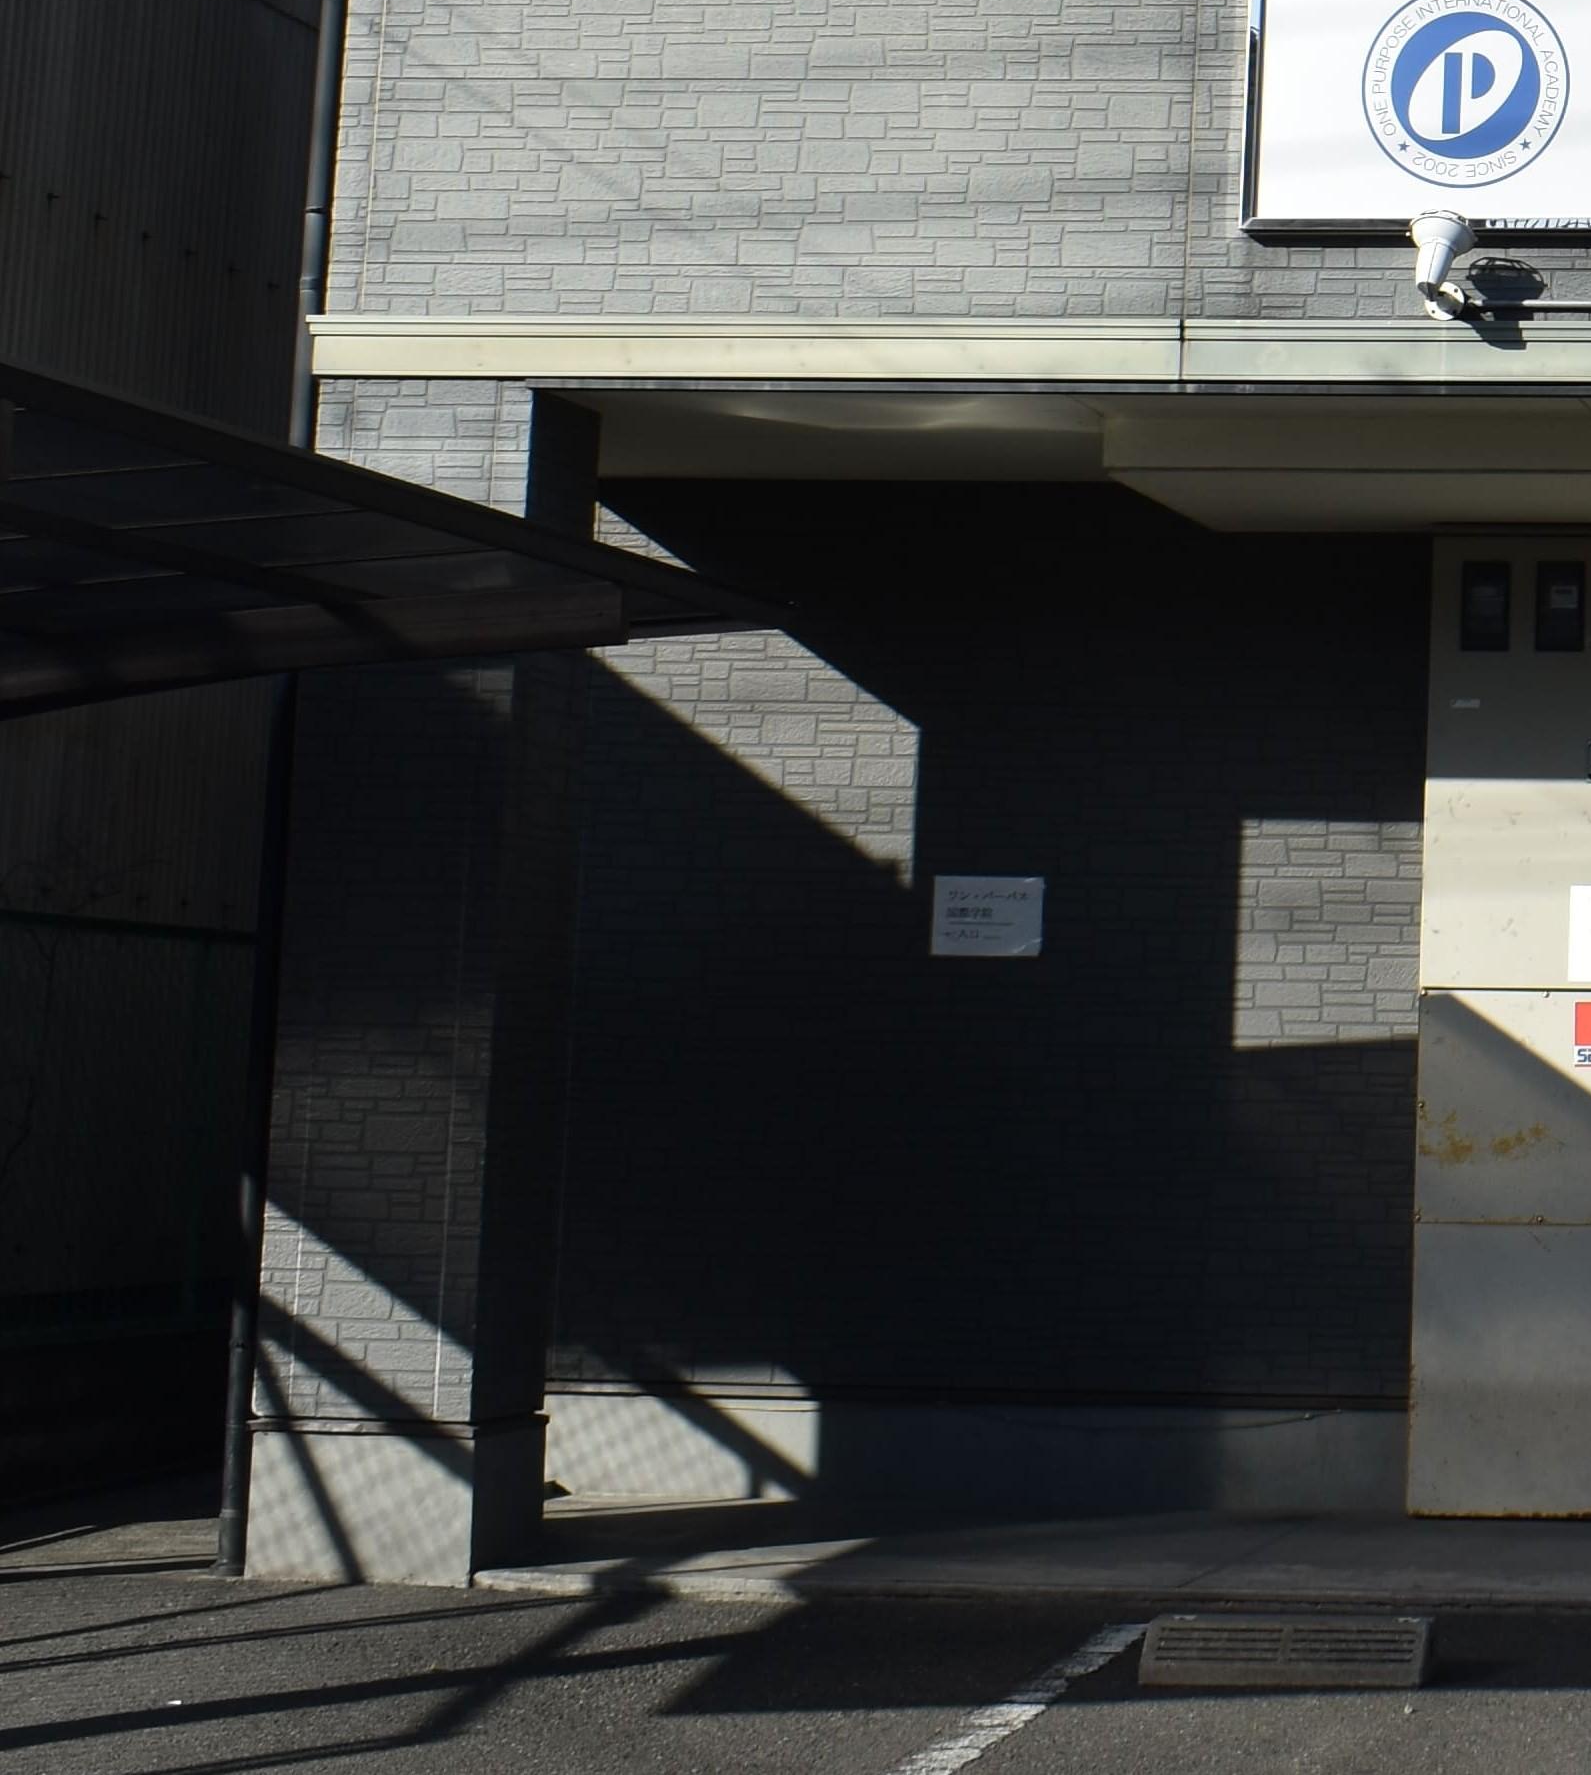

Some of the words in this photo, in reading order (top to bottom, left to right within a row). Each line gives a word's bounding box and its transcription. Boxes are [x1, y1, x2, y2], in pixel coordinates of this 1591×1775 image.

[1372, 16, 1418, 95] PURPOSE
[1532, 49, 1560, 138] ACADEMY
[1374, 99, 1398, 137] ONE
[1411, 151, 1460, 178] 2002
[1465, 150, 1518, 178] SINCE
